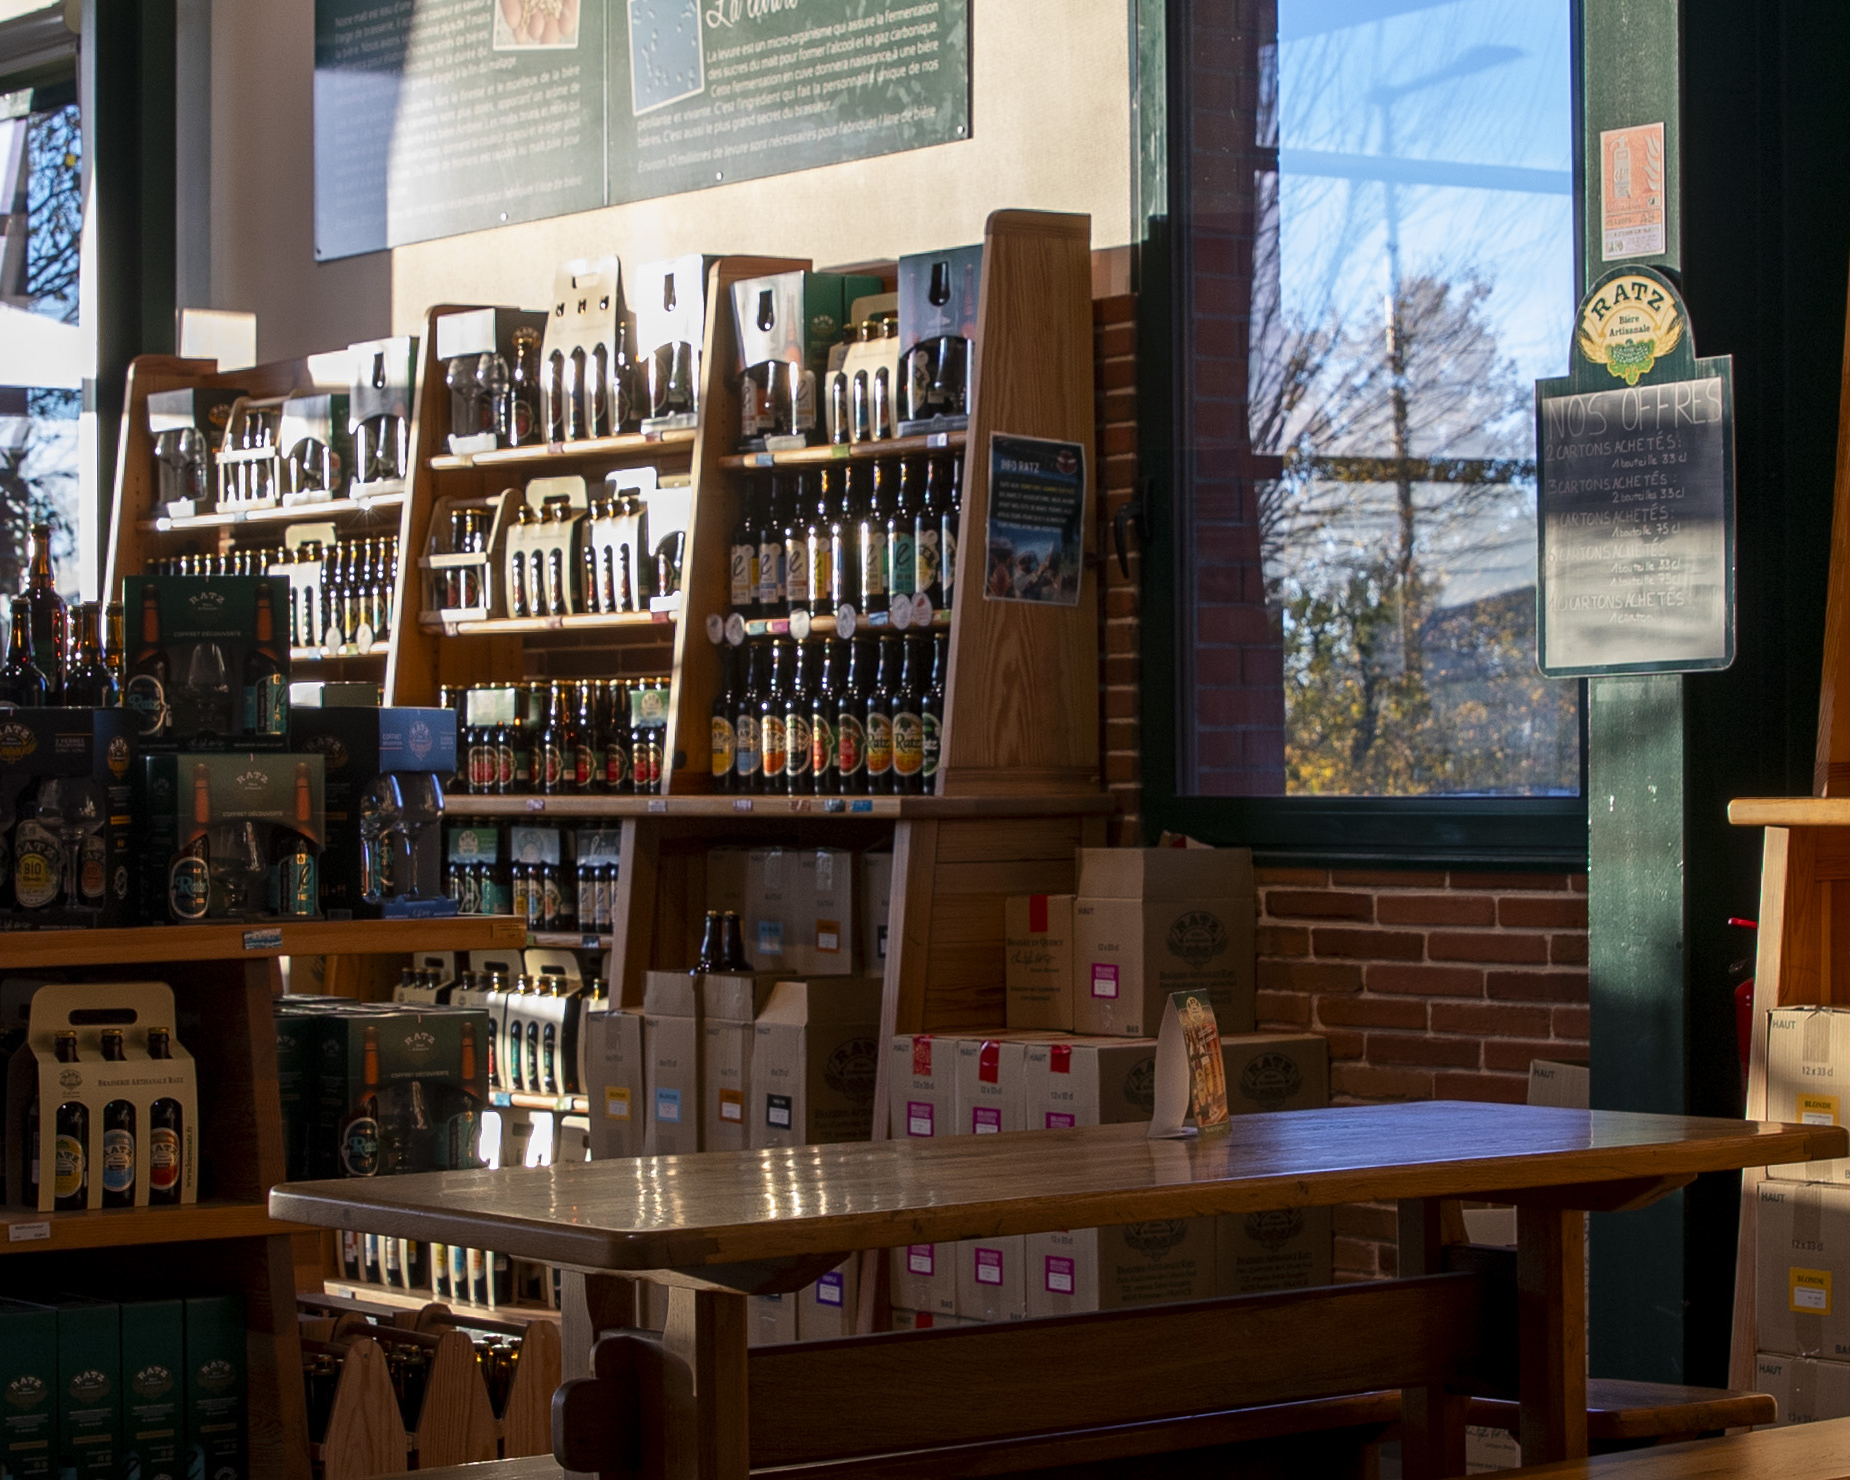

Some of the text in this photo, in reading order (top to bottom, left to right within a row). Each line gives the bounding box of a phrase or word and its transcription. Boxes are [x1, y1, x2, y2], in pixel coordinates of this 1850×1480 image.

[1591, 282, 1665, 321] RATZ
[1619, 315, 1640, 325] Bière
[1609, 324, 1650, 337] Artisanale
[1548, 380, 1722, 440] NOS OFFRES
[24, 863, 41, 874] BIO
[1178, 913, 1219, 936] RATZ
